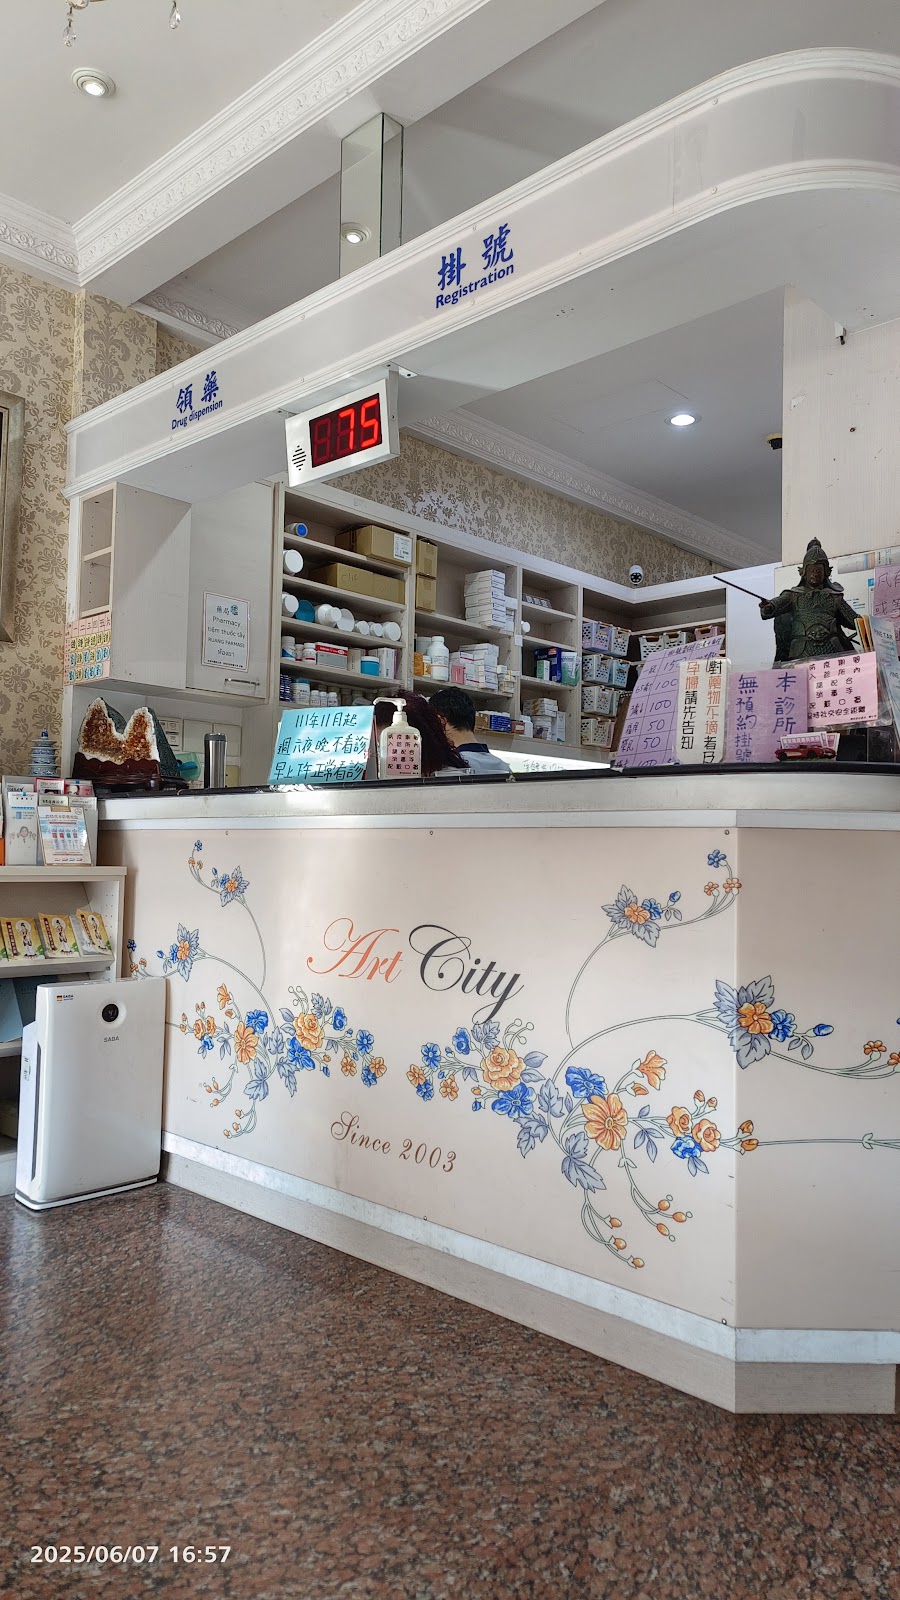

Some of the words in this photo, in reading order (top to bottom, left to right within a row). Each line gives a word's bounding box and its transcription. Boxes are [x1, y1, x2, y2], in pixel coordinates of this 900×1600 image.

[437, 223, 514, 291] 掛號
[435, 264, 514, 309] Registration
[176, 370, 219, 414] 領藥
[171, 416, 188, 430] Drug
[188, 400, 223, 421] dispension
[338, 398, 379, 451] 75
[212, 615, 242, 629] Pharmacy
[655, 678, 679, 690] 100
[295, 712, 358, 728] 111年11月起
[650, 699, 672, 713] 100
[680, 661, 700, 750] 孕婦請先告知
[772, 671, 797, 749] 本診所
[643, 736, 660, 750] 50
[647, 719, 665, 732] 50
[277, 733, 369, 756] 週六夜晚不看診
[306, 917, 404, 984] Art
[408, 924, 525, 1026] City
[330, 1110, 392, 1155] Since
[398, 1138, 457, 1173] 2003
